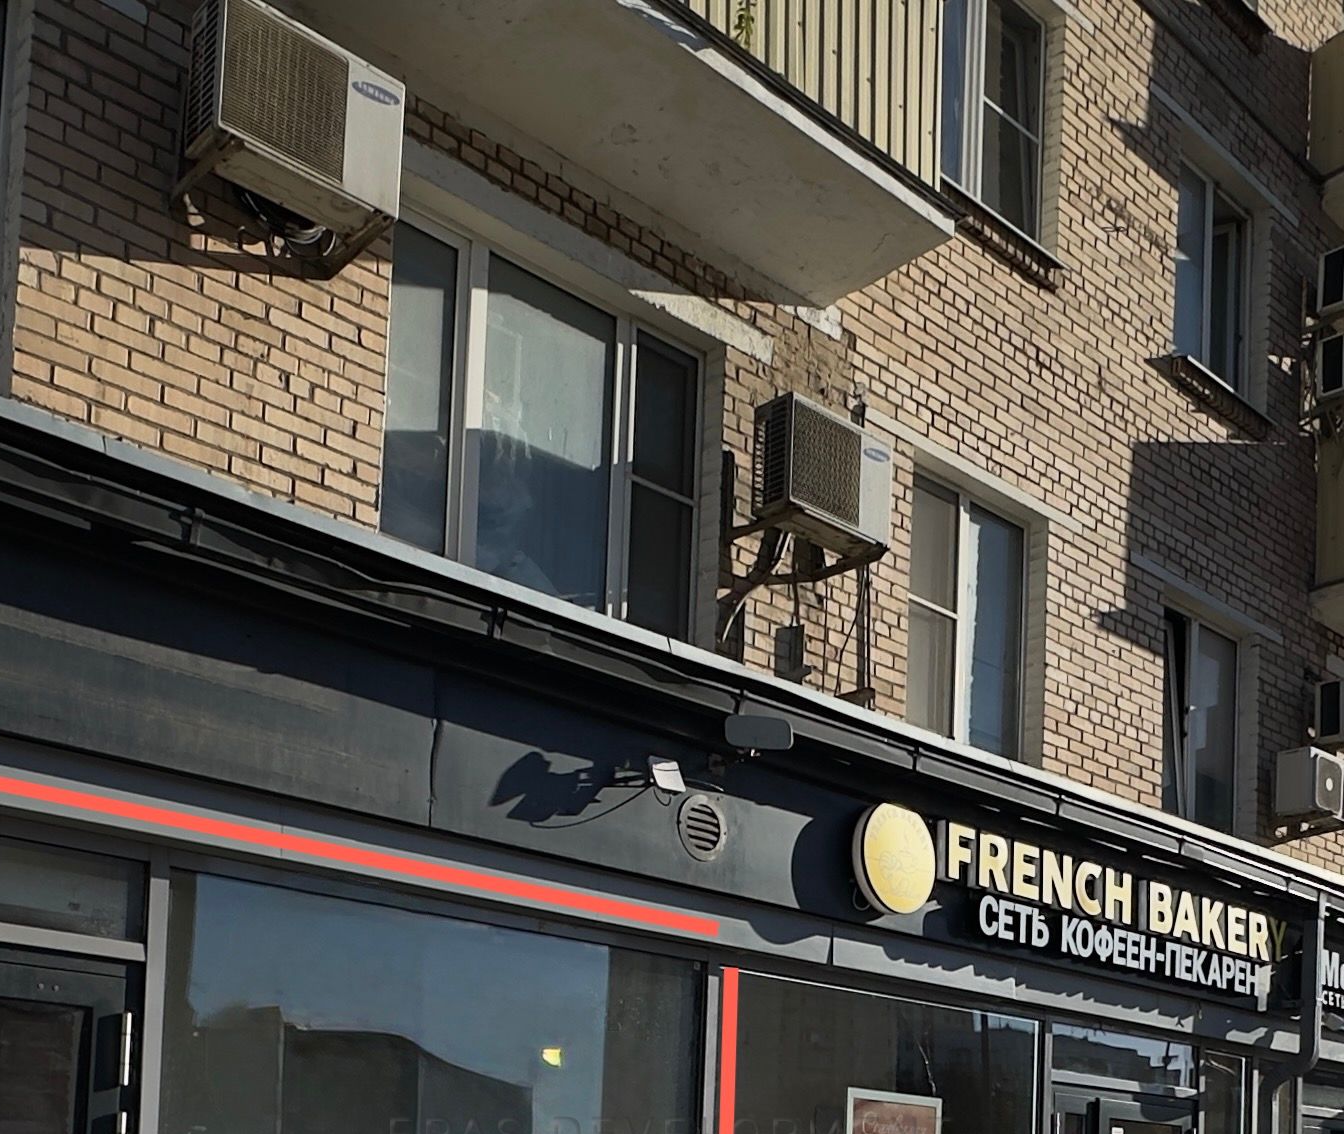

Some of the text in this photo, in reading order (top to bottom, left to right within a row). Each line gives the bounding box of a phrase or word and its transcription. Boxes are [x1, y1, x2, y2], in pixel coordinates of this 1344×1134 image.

[947, 821, 1287, 962] FRENCH BAKERY
[979, 895, 1260, 997] СЕТЬ КОФЕЕН-ПЕКАРЕН
